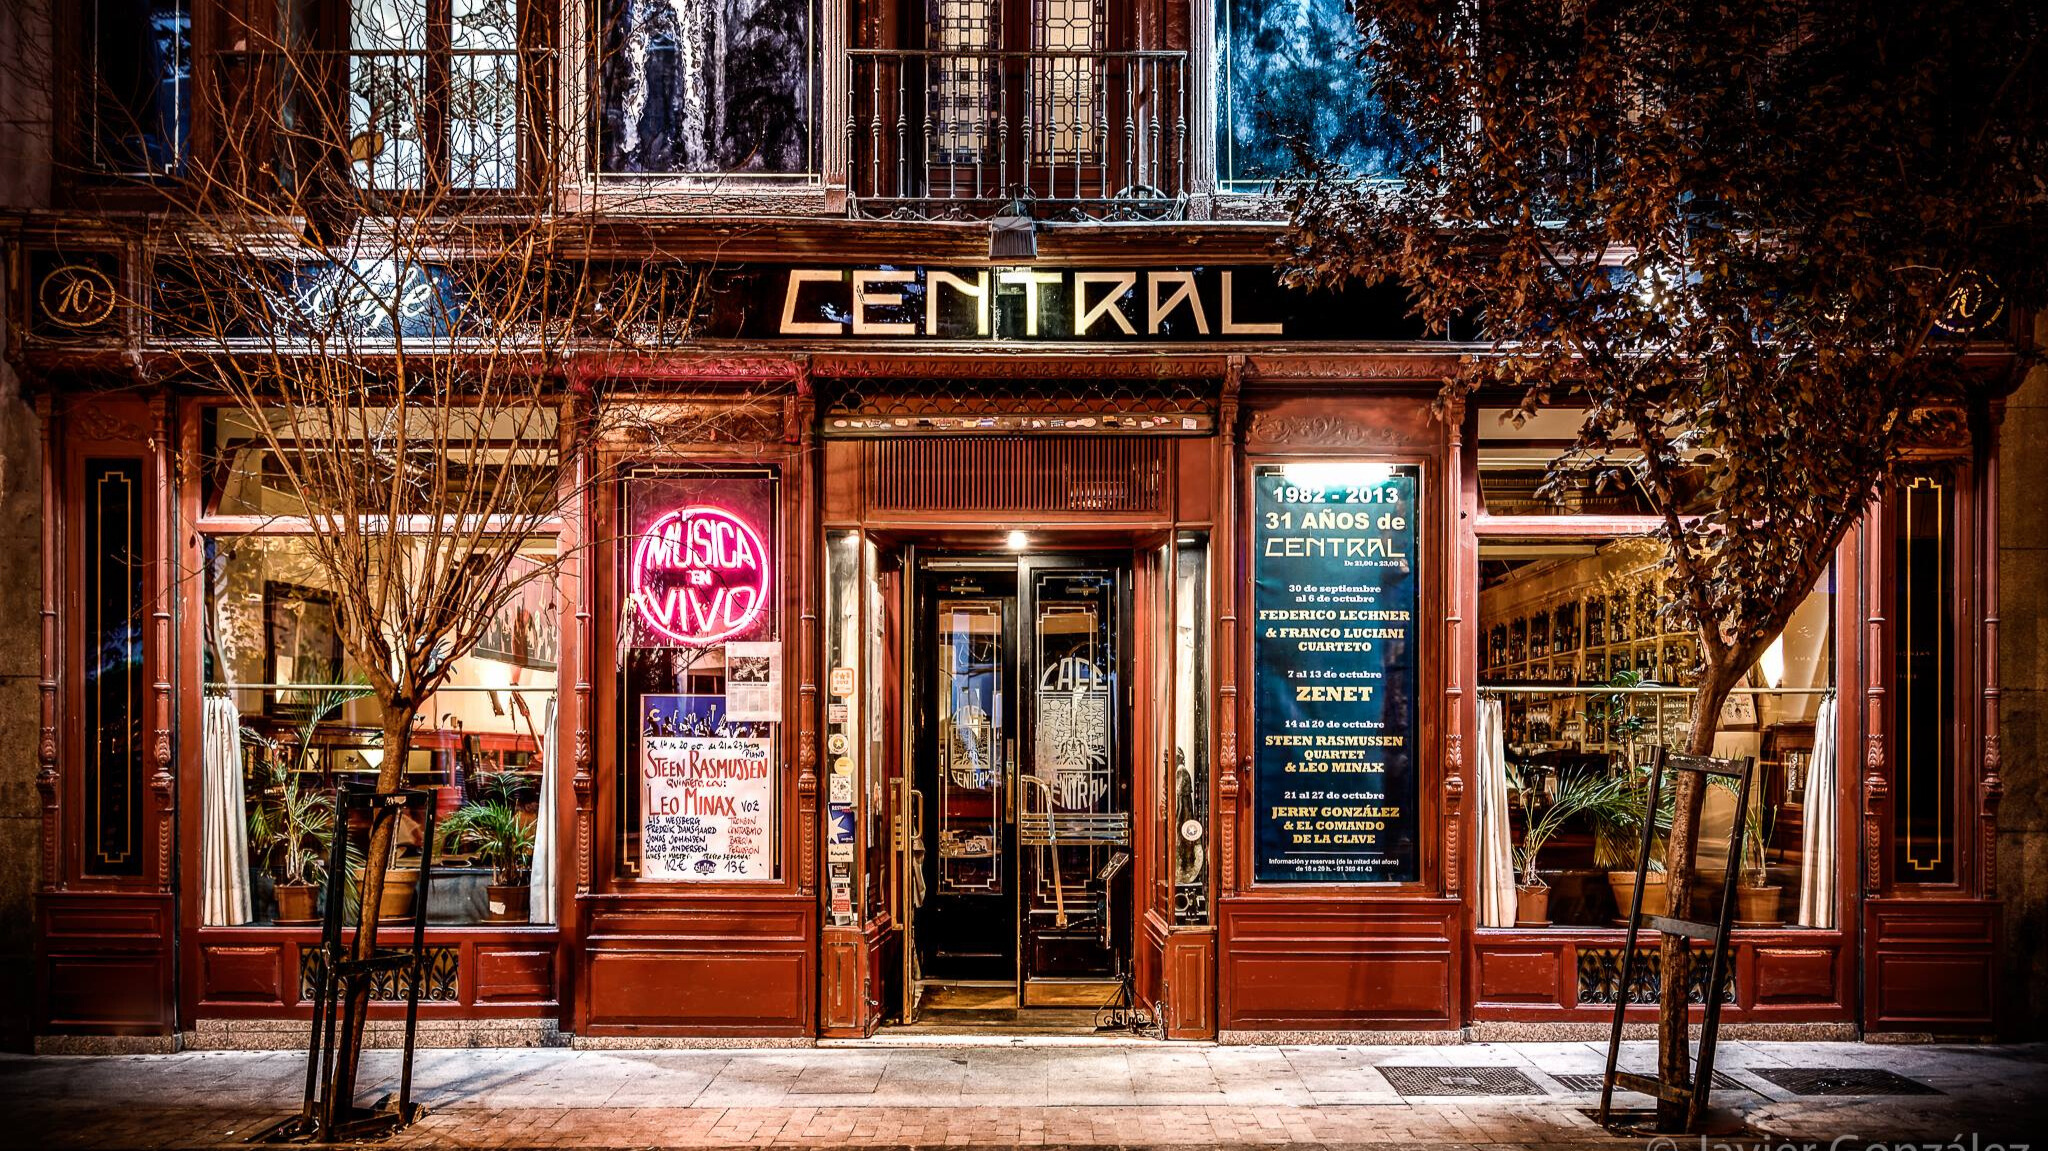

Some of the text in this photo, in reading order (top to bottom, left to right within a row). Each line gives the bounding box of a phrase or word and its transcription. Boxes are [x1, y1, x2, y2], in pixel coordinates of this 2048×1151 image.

[58, 278, 94, 313] 10
[779, 269, 1283, 335] CENTRAL
[1273, 486, 1326, 503] 1982
[1345, 486, 1399, 503] 2013
[1265, 509, 1406, 530] 31 AÑOS de
[1264, 538, 1406, 557] CENTRAL
[687, 569, 712, 586] EN
[1289, 585, 1382, 594] 30 de septiembre
[1296, 595, 1374, 603] al 6 de octubre
[643, 586, 757, 632] VIVO
[1260, 610, 1410, 621] FEDERICO LECHNER
[1266, 628, 1404, 638] & FRANCO LUCIANI
[1298, 642, 1372, 652] CUARTETO
[1296, 686, 1373, 702] ZENET
[1285, 720, 1384, 728] 14 al 20 de octubre
[680, 740, 688, 750] 20
[718, 740, 727, 750] 21
[733, 740, 742, 750] 23
[1265, 736, 1404, 746] STEEN RASMUSSEN
[1304, 750, 1366, 761] QUARTET
[644, 749, 768, 780] STEEN RASMUSSEN
[1284, 762, 1385, 773] & LEO MINAX
[648, 786, 680, 816] LEO
[684, 788, 736, 816] MINAX
[1284, 792, 1384, 800] 21 al 27 de octubre
[1272, 805, 1400, 819] JERRY GONZÁLEZ
[1284, 821, 1385, 830] & EL COMANDO
[1293, 834, 1376, 844] DE LA CLAVE
[670, 844, 708, 854] ANDERSEN
